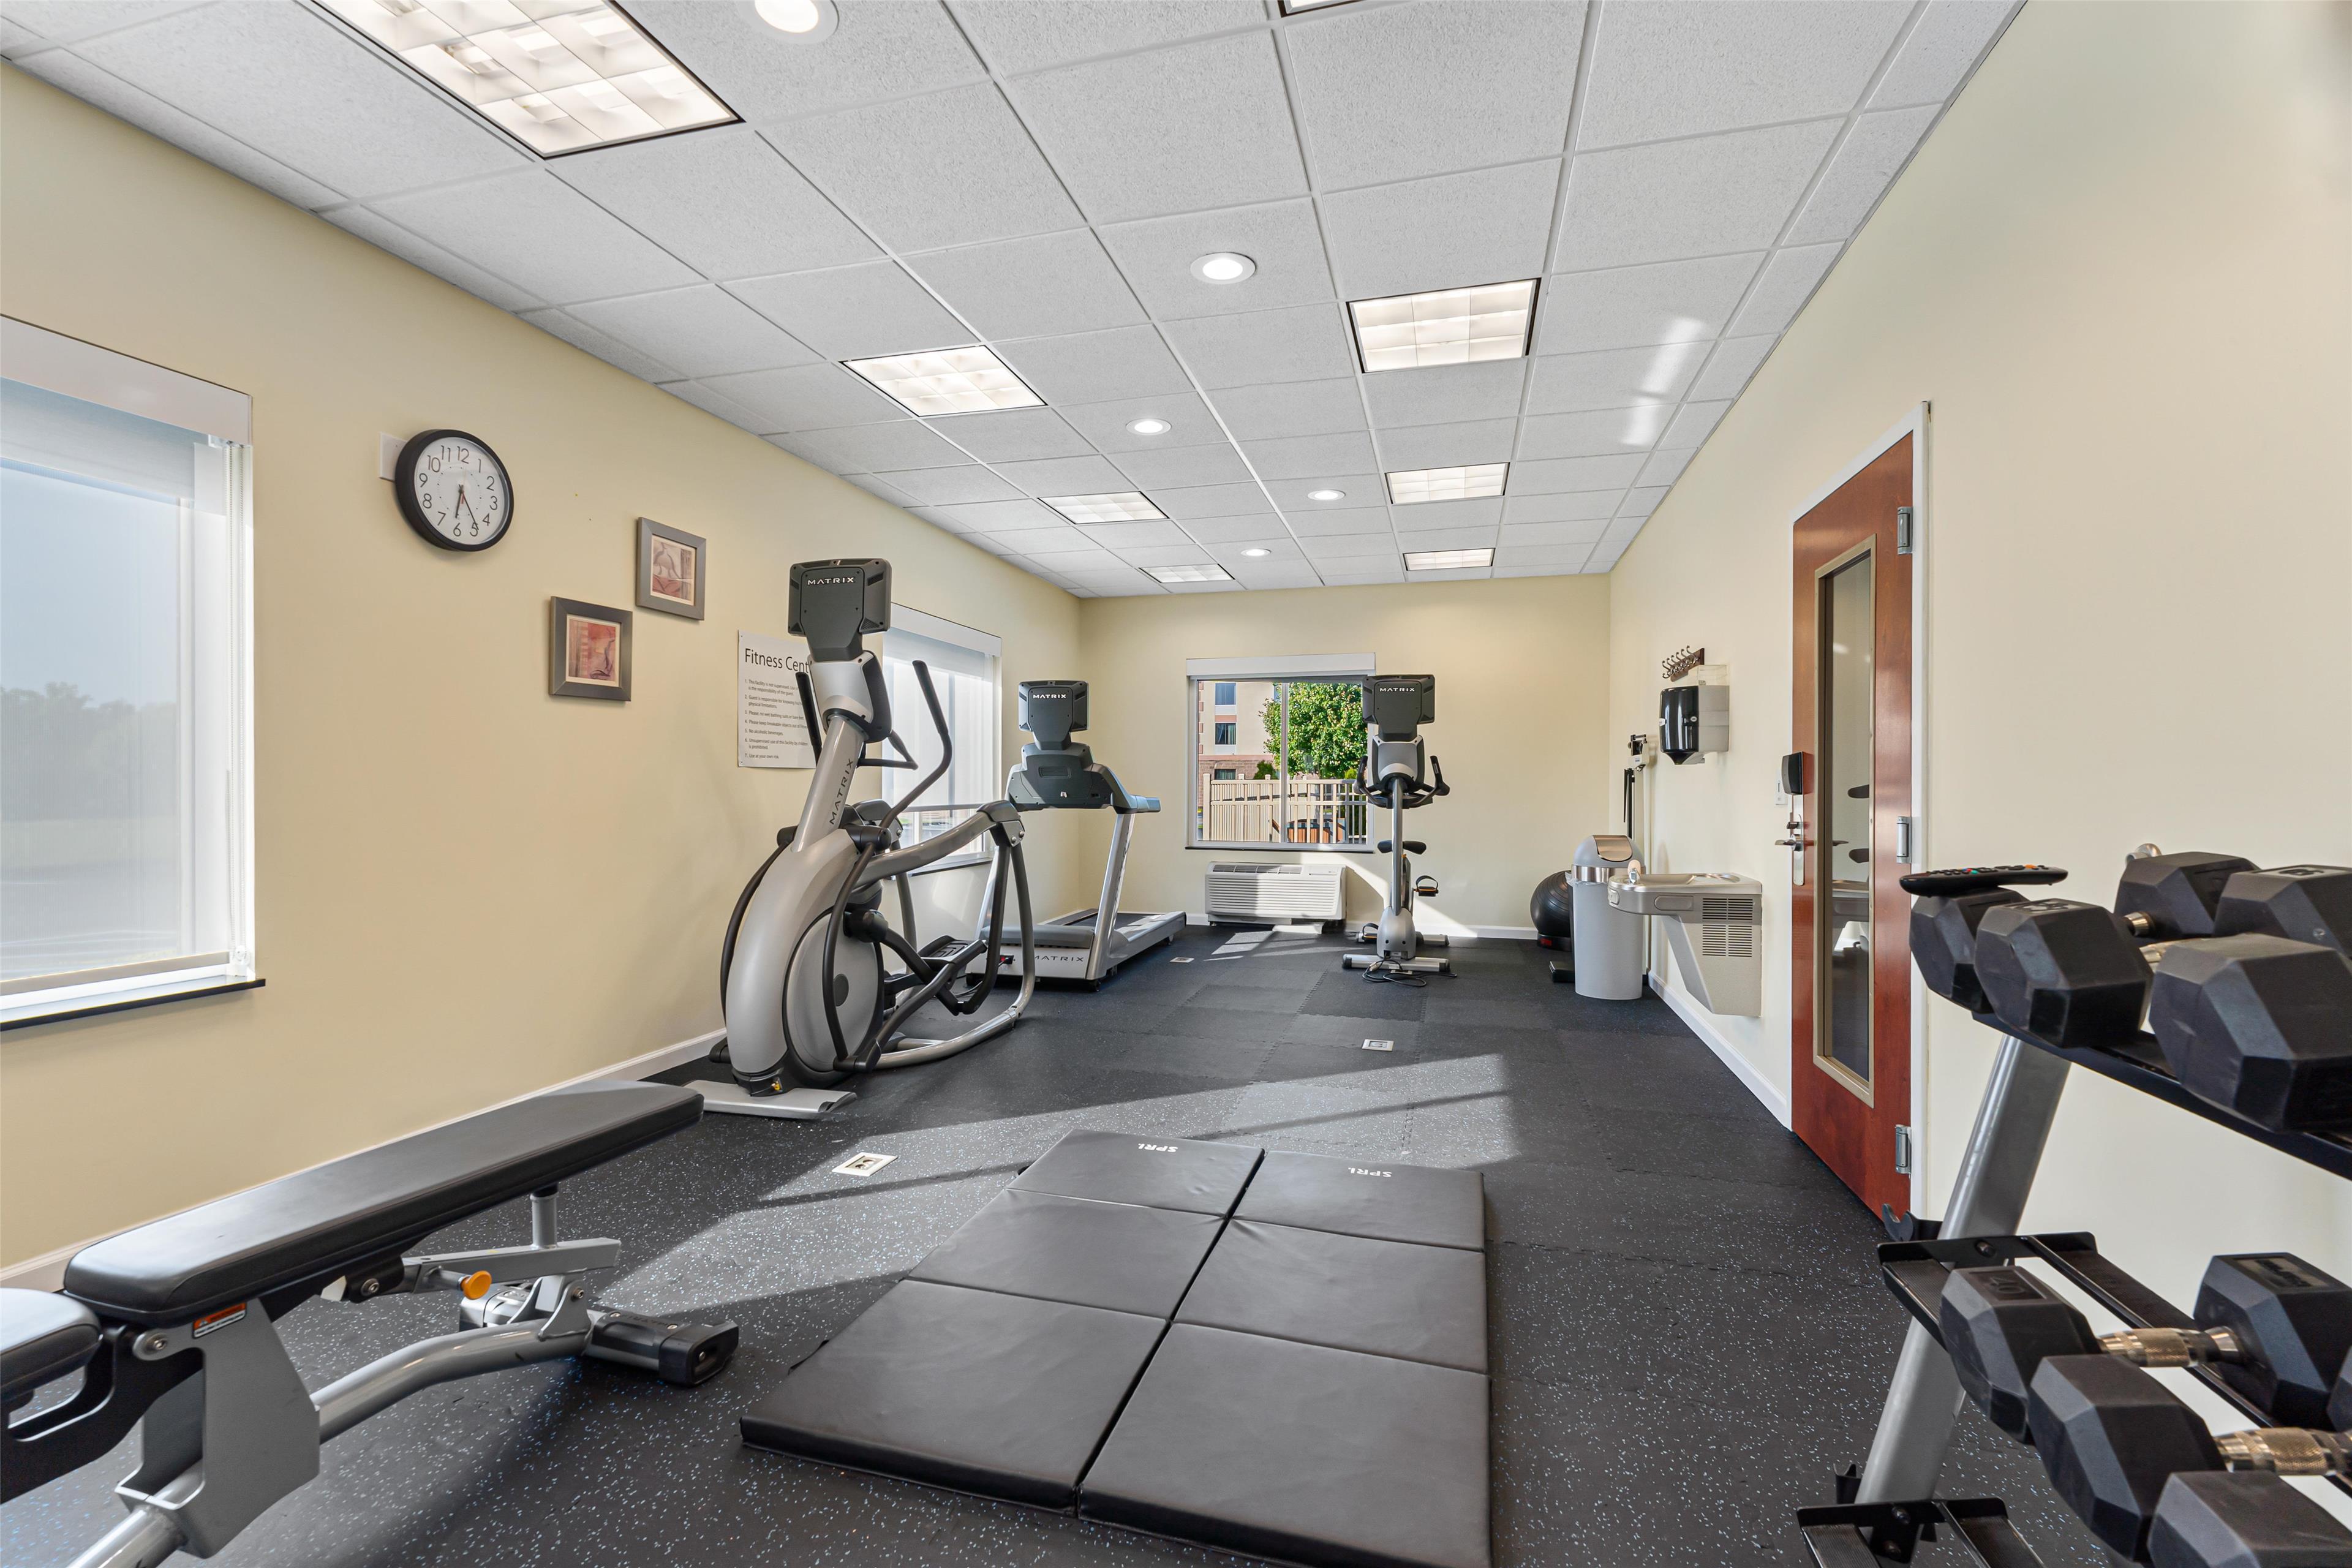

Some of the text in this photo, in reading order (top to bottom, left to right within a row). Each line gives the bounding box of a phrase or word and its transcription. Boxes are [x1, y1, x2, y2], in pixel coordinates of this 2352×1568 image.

[441, 445, 451, 462] 11
[457, 446, 469, 464] 12
[428, 455, 441, 472] 10
[419, 473, 428, 488] 9
[486, 476, 495, 491] 2
[423, 493, 432, 508] 8
[489, 496, 498, 510] 3
[437, 511, 447, 526] 7
[482, 513, 491, 526] 4
[453, 522, 462, 537] 6
[469, 522, 478, 537] 5
[745, 648, 809, 674] Fitness Cent
[829, 758, 853, 824] MATRIX
